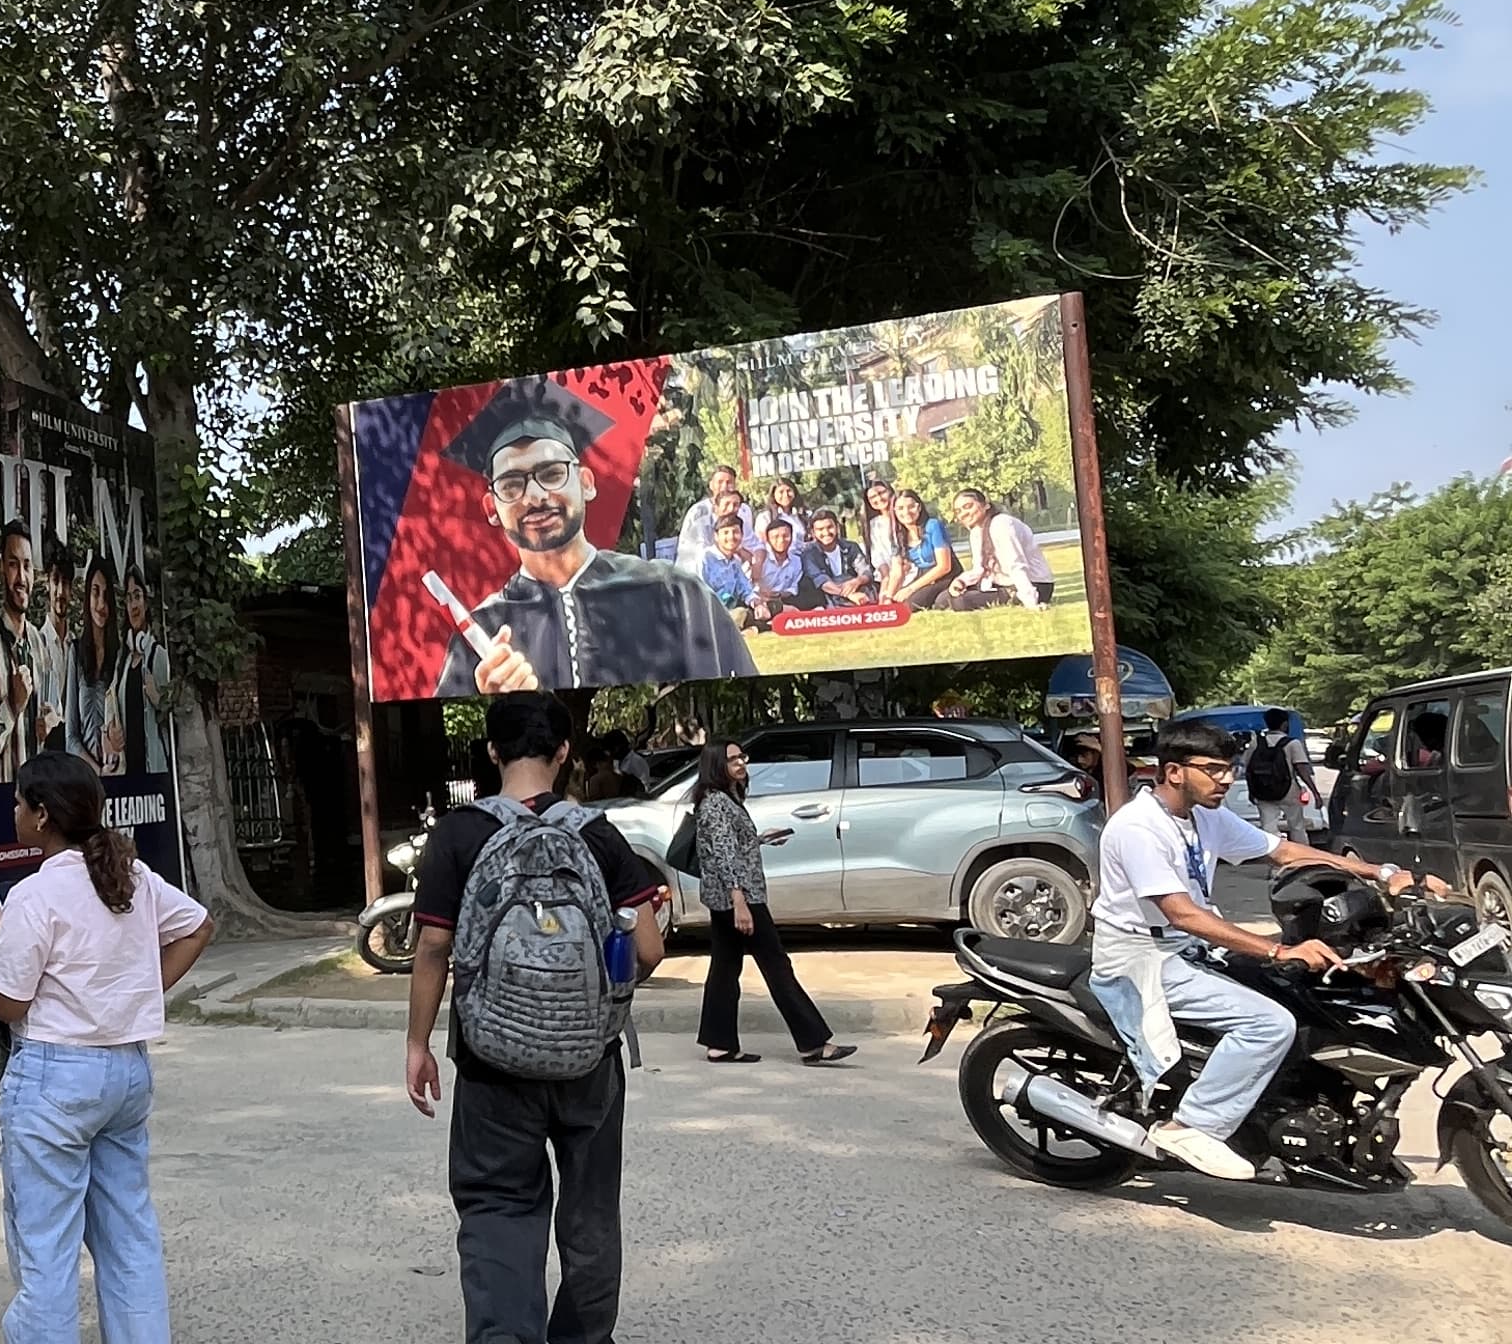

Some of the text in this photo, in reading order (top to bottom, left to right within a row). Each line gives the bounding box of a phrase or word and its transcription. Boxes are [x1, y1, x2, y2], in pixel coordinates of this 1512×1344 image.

[748, 391, 809, 426] JOIN
[812, 383, 868, 418] THE
[873, 365, 1000, 409] LEADING
[64, 420, 119, 451] UNIVERSITY
[750, 406, 920, 455] UNIVERSITY
[751, 440, 889, 477] IN DELHI-NCR
[784, 610, 897, 630] ADMISSION 2025
[115, 793, 165, 826] LEADING
[1281, 1135, 1307, 1146] TVS
